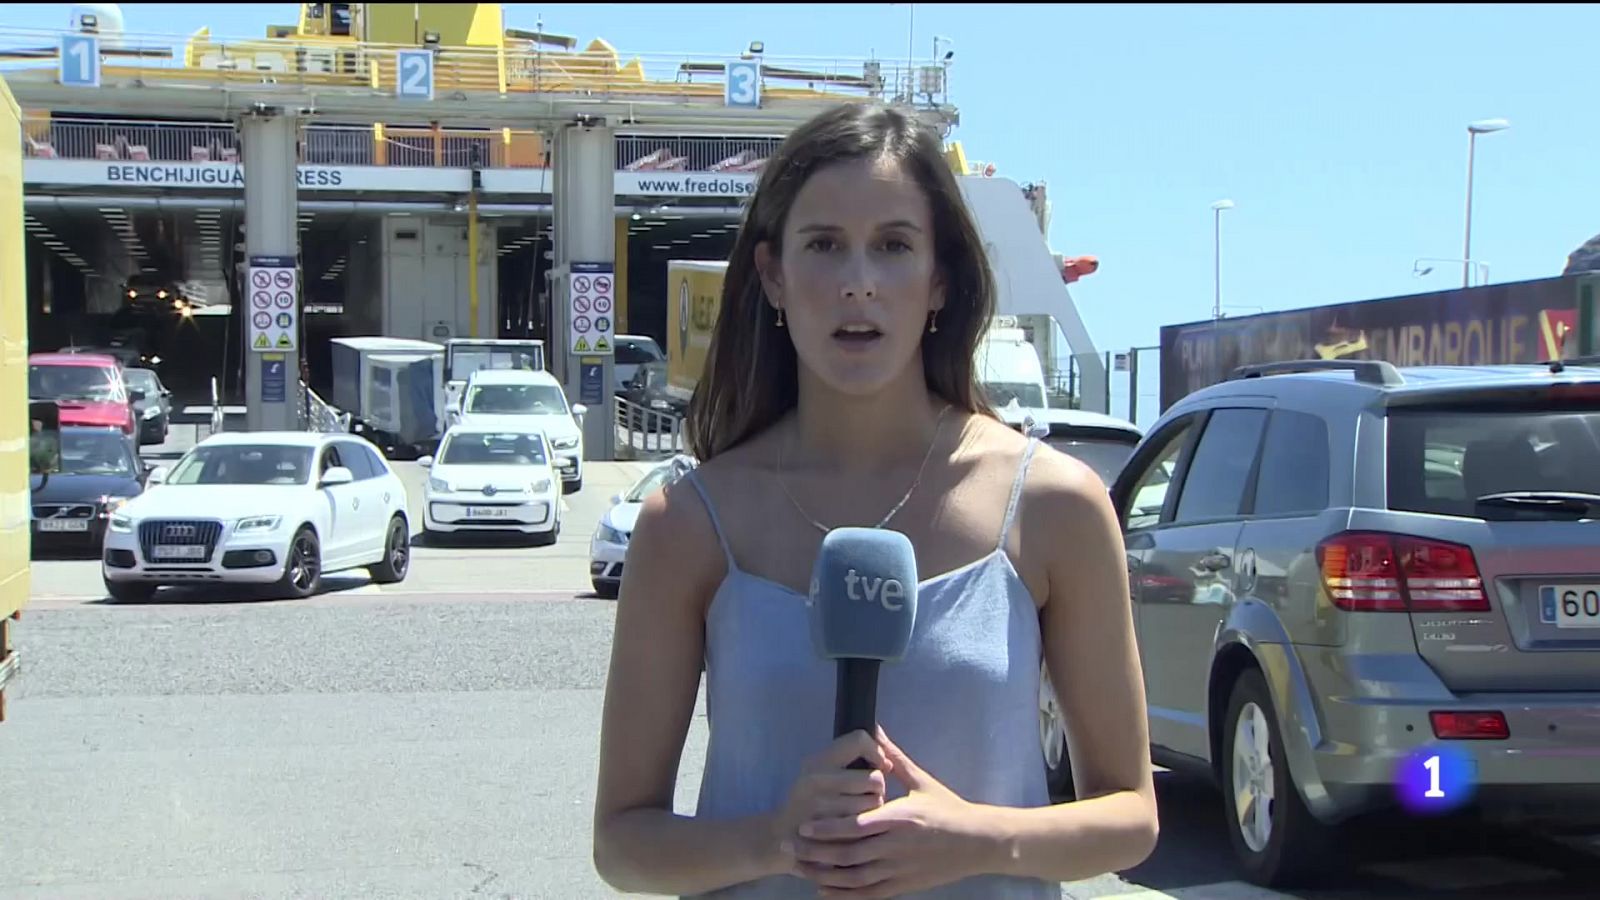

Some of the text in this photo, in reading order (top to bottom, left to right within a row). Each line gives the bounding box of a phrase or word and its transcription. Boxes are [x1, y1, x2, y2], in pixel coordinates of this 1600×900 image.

[70, 40, 91, 81] 1
[403, 56, 429, 95] 2
[731, 65, 755, 103] 3
[107, 165, 342, 186] BENCHIJIGUA RESS
[638, 178, 756, 194] www.fredolse
[844, 569, 904, 612] tve
